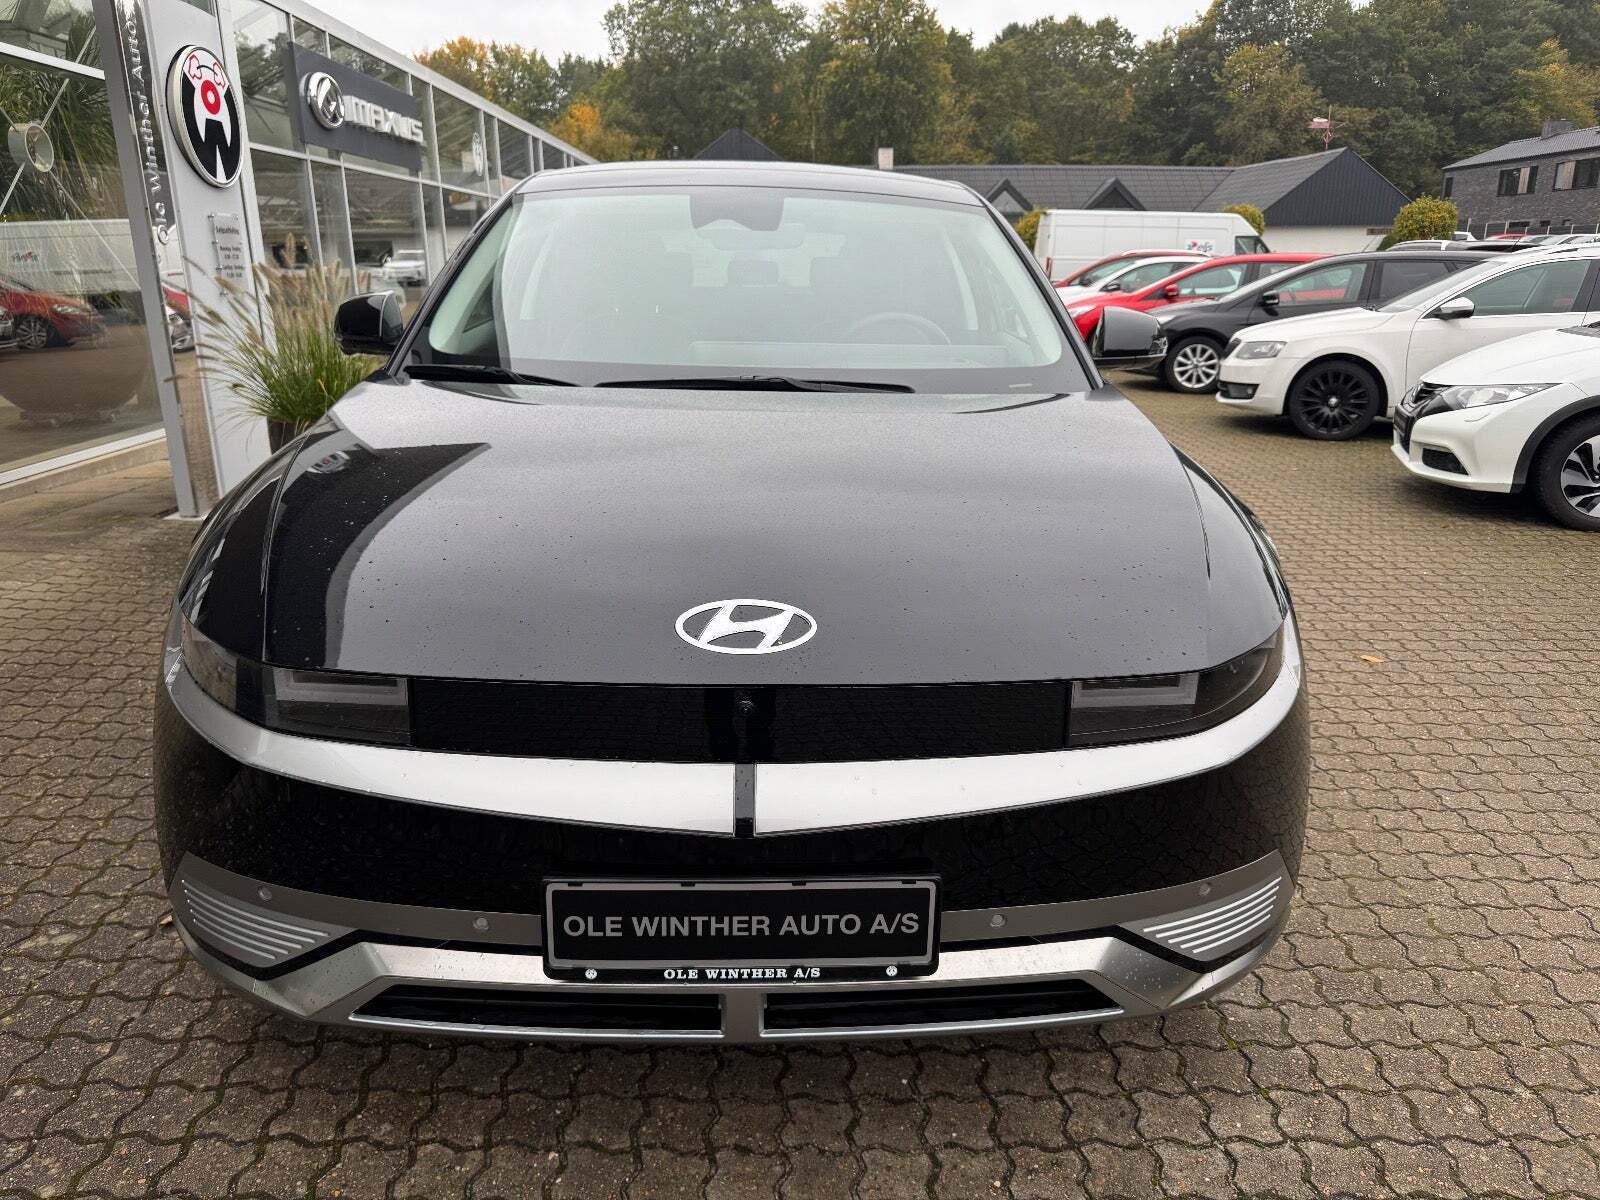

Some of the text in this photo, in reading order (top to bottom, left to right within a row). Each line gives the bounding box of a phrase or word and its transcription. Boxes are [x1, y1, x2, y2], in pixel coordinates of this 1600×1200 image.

[342, 95, 424, 142] MAXUS
[154, 202, 169, 245] Ole
[563, 912, 919, 937] OLE WINTHER AUTO A/S
[664, 967, 821, 980] OLE WINTHER A/S
